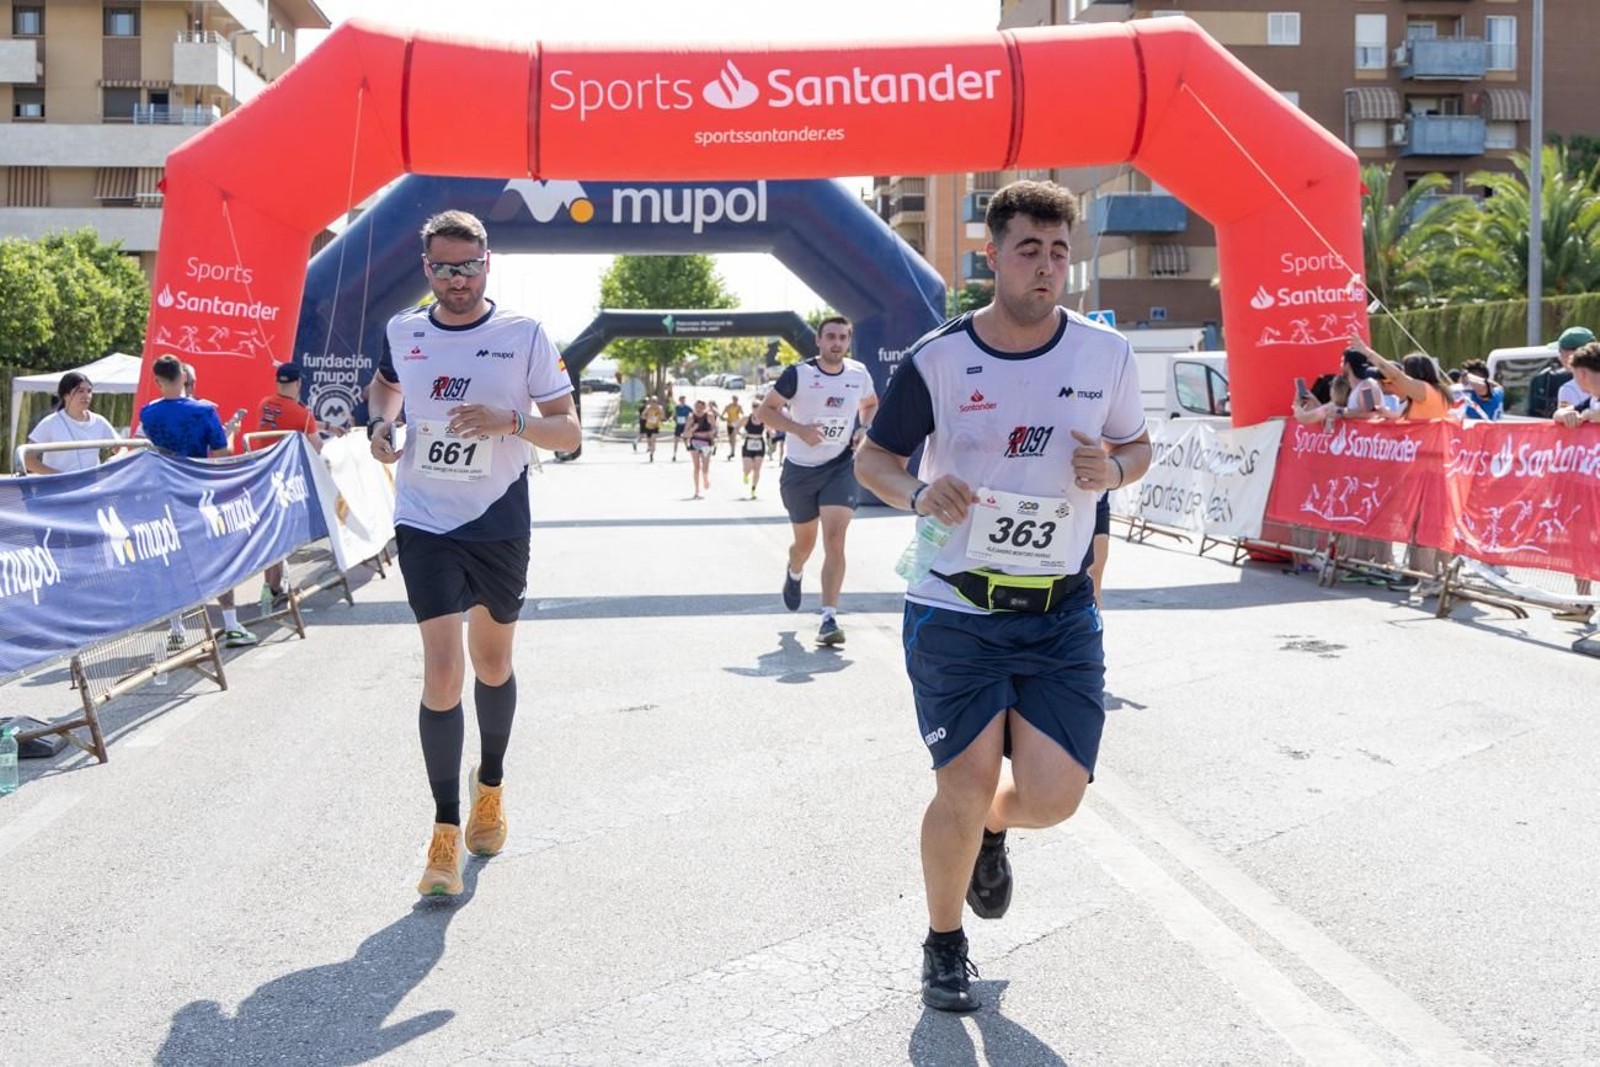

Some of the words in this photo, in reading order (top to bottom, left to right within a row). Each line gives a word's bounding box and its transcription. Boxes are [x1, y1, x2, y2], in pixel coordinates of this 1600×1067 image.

[549, 69, 694, 121] Sports
[767, 62, 1002, 108] Santander
[694, 126, 845, 147] sportssantander.es
[611, 179, 767, 233] mupol
[186, 256, 253, 284] Sports
[1280, 252, 1345, 276] Sports
[175, 290, 280, 321] Santander
[302, 352, 372, 369] fundación
[491, 351, 514, 359] mupol
[313, 370, 359, 384] mupol
[958, 402, 997, 413] Santander
[1077, 389, 1103, 400] mupol
[428, 440, 477, 466] 661
[1345, 428, 1421, 463] Santander
[132, 504, 181, 567] mupol
[989, 516, 1056, 549] 363
[0, 527, 61, 606] mupol
